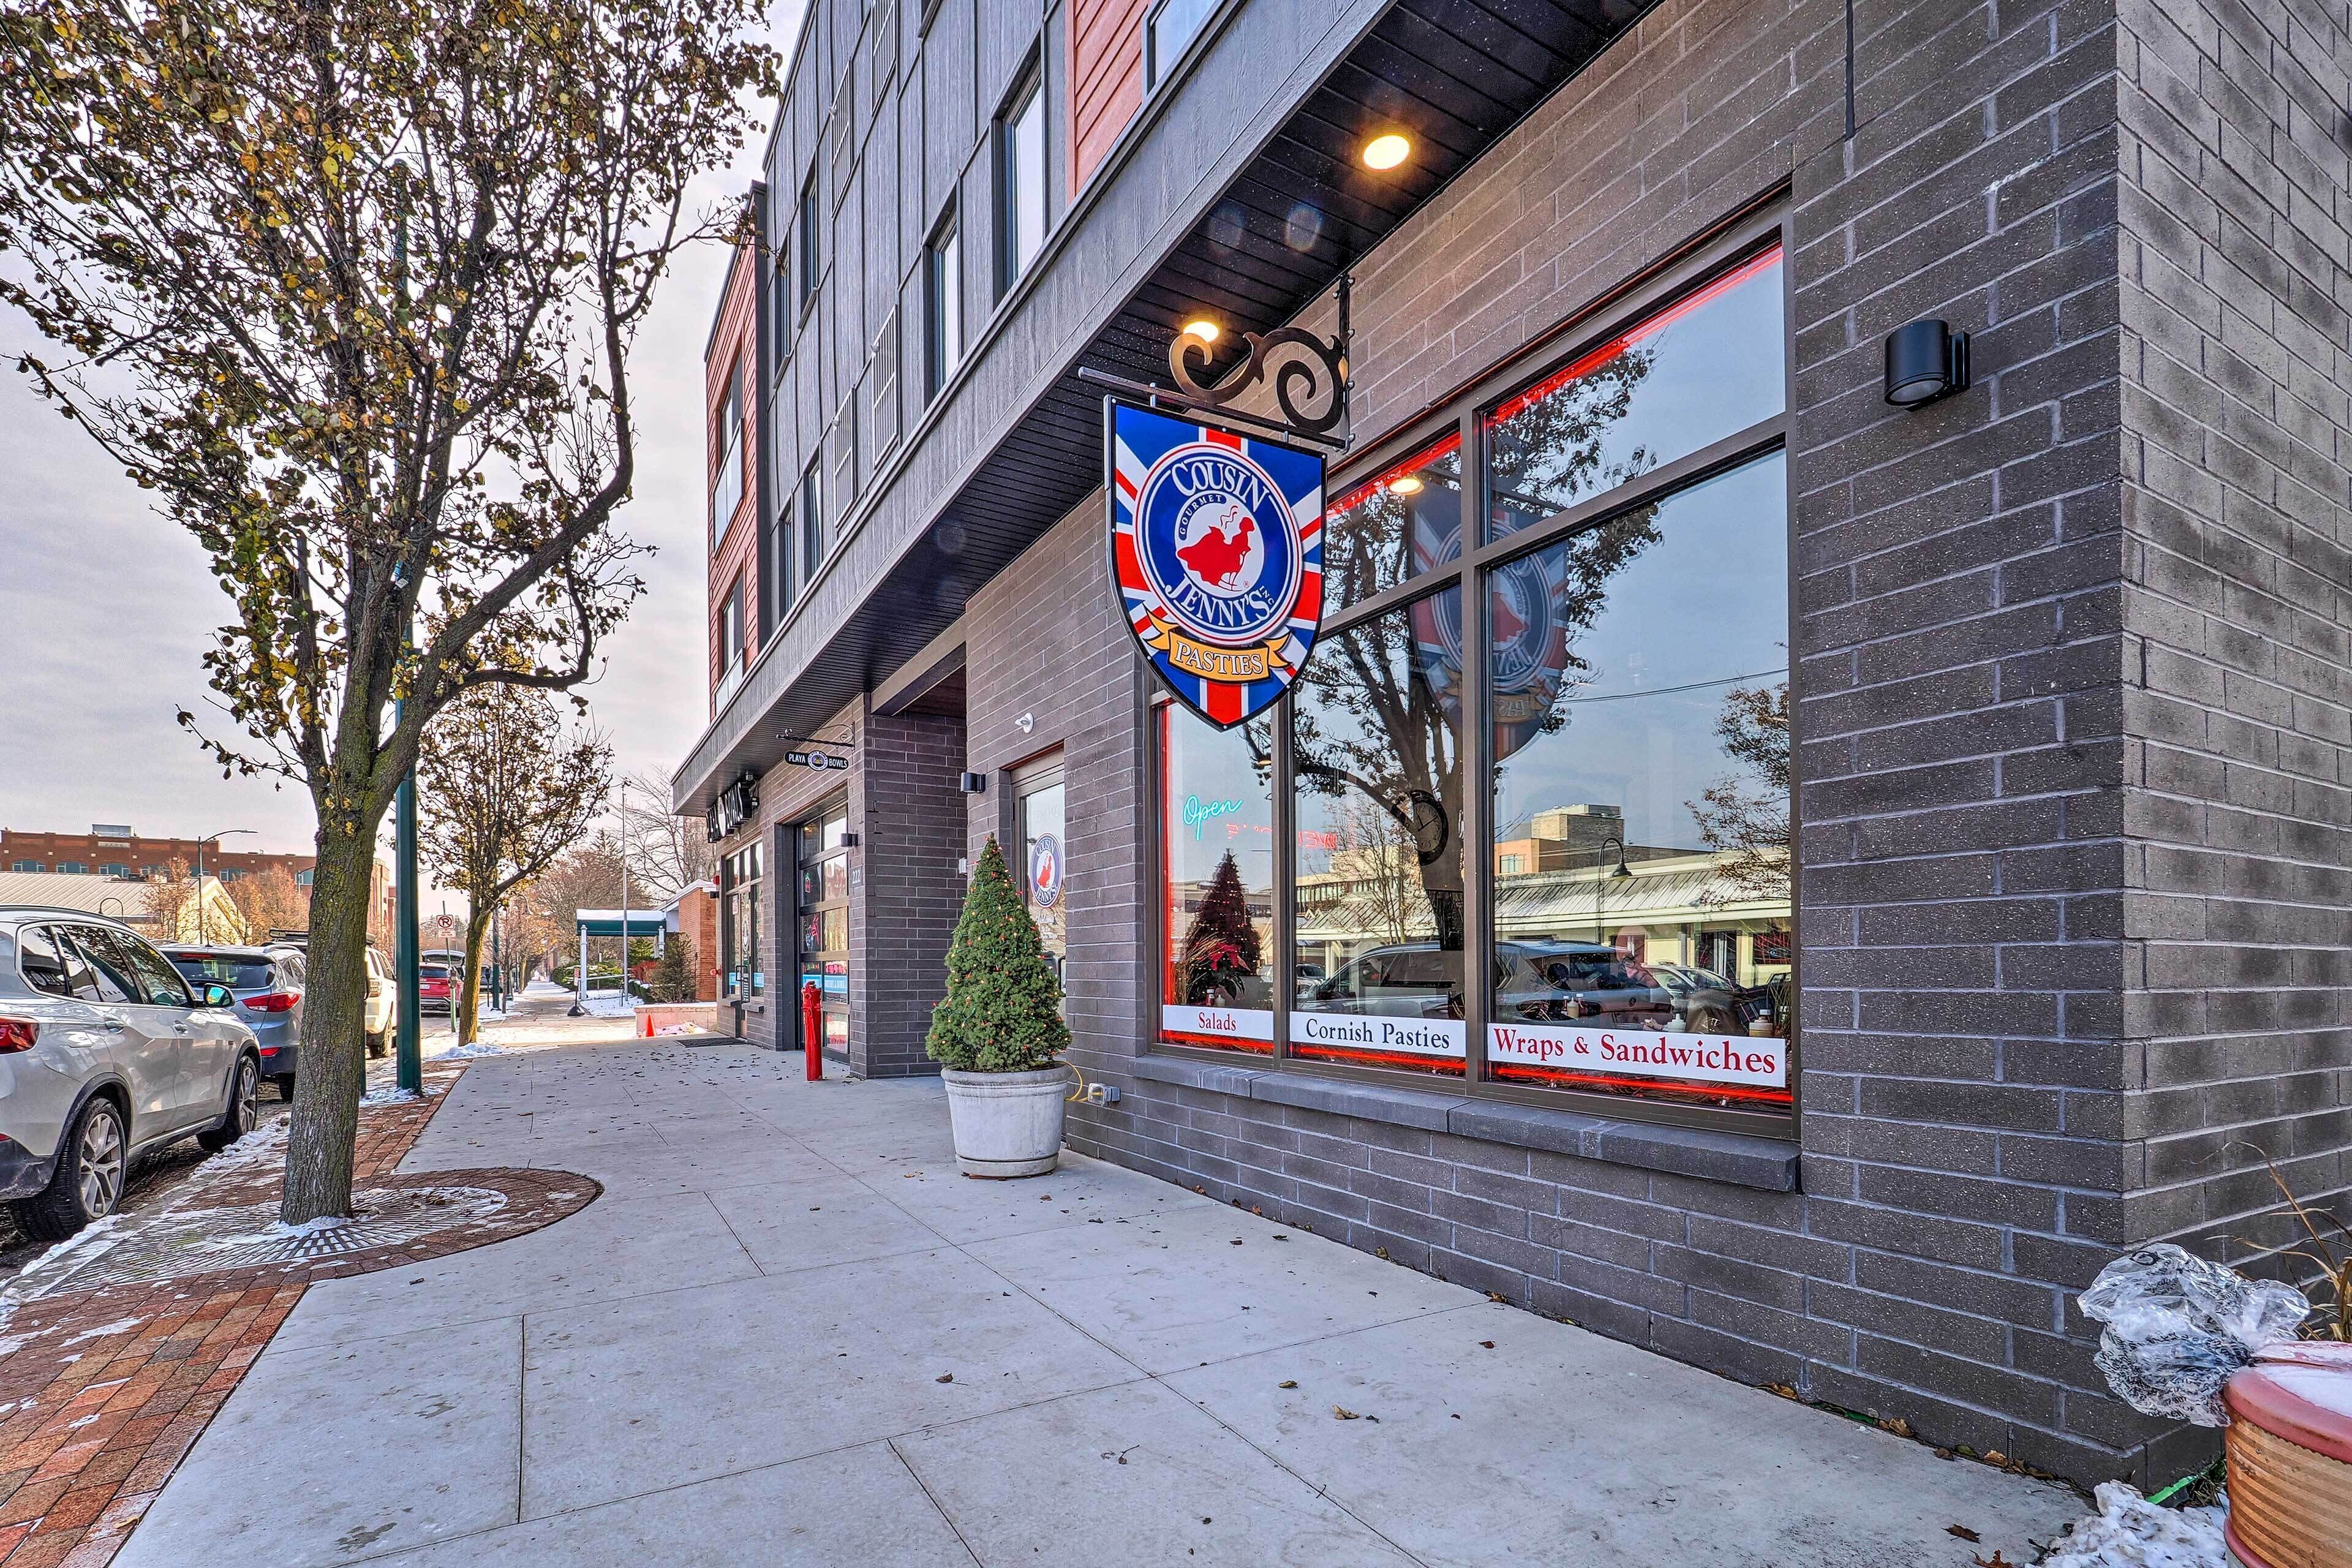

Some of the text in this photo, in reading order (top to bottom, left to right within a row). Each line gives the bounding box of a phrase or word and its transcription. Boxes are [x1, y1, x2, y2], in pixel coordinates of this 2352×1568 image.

[1172, 461, 1270, 513] COUSIN
[1180, 494, 1222, 535] GOURMET
[1165, 573, 1270, 627] JENNY'S
[1174, 641, 1263, 676] PASTIES
[788, 753, 806, 763] PLAYA
[829, 758, 848, 768] BOWLS
[1183, 794, 1243, 841] Open
[1198, 1012, 1237, 1031] Salads
[1306, 1018, 1450, 1049] Cornish Pasties
[1493, 1028, 1776, 1074] Wraps & Sandwiches
